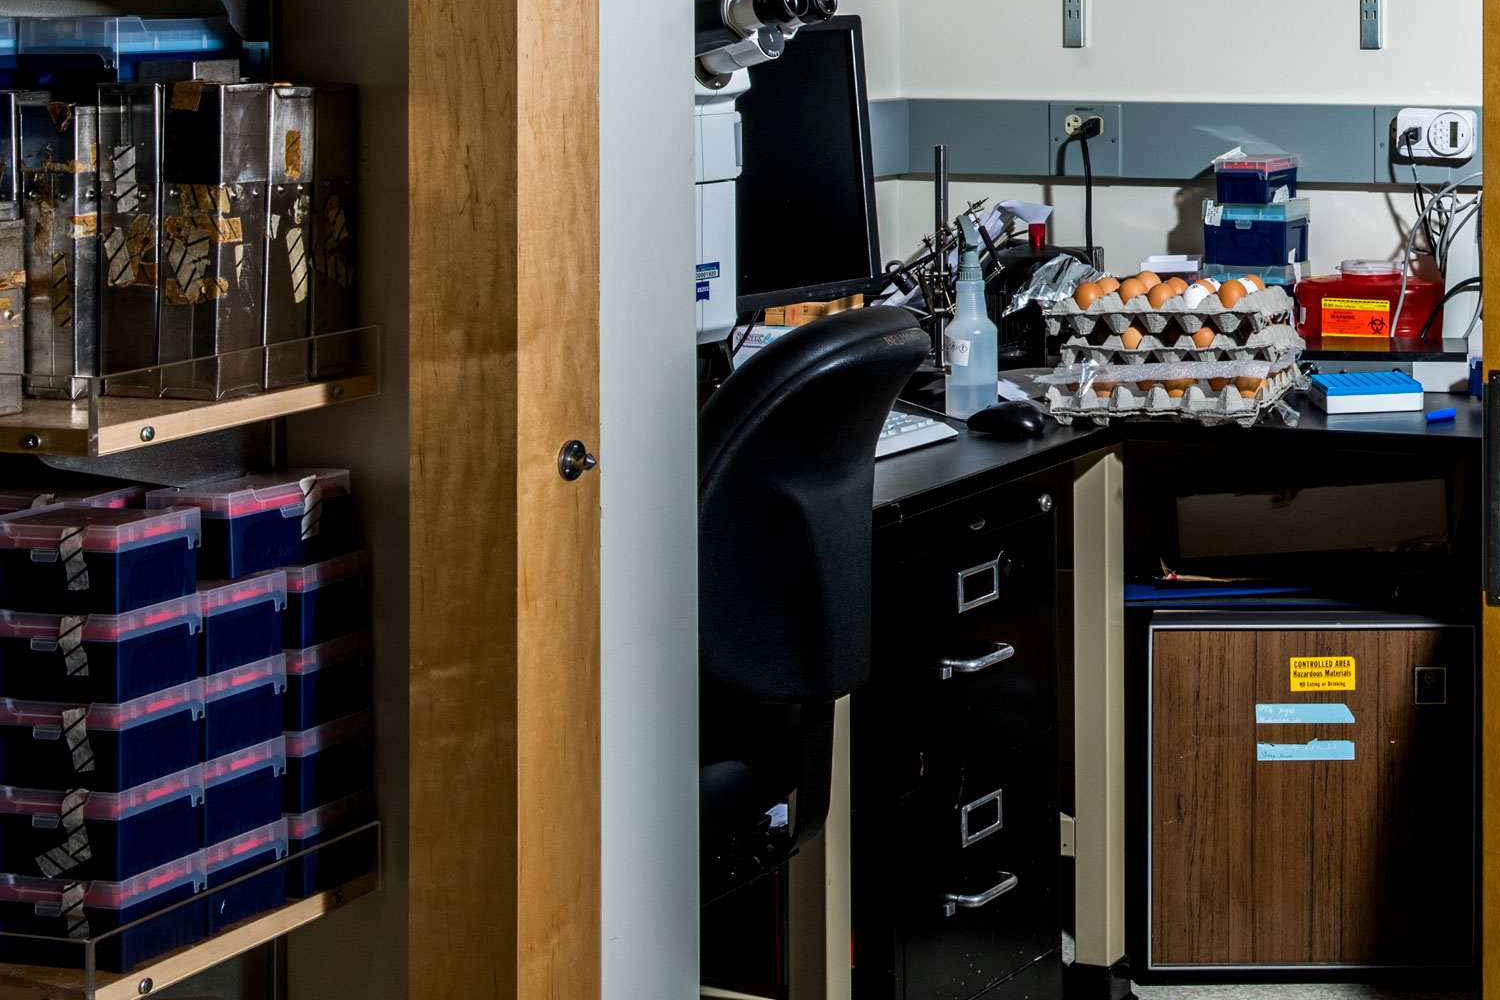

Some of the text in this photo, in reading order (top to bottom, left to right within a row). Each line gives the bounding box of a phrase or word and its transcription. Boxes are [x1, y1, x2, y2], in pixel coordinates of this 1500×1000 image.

[1293, 660, 1333, 668] CONTROLLED
[1293, 669, 1352, 678] Hazardous Materials
